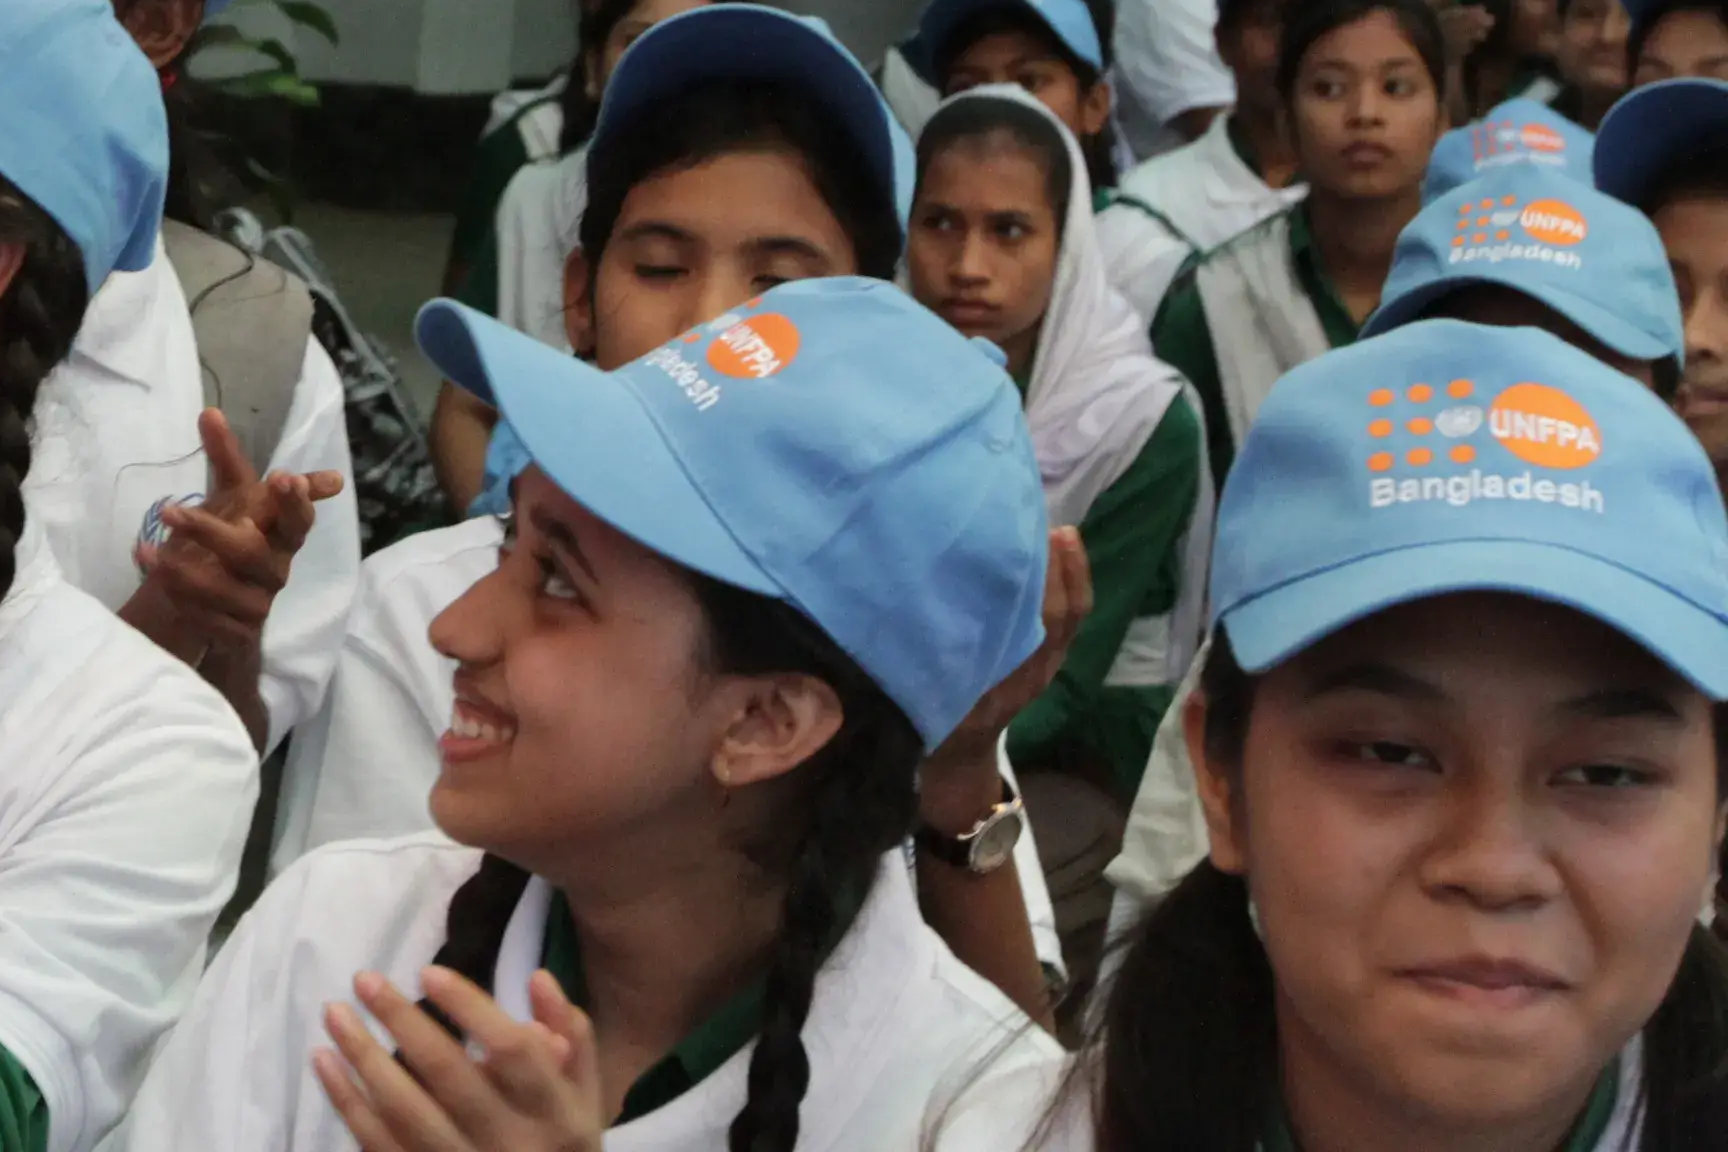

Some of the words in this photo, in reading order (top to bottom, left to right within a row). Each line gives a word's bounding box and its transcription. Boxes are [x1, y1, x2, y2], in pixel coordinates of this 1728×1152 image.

[1520, 209, 1586, 239] UNFPA
[1488, 407, 1600, 454] UNFPA
[1368, 468, 1604, 515] Bangladesh
